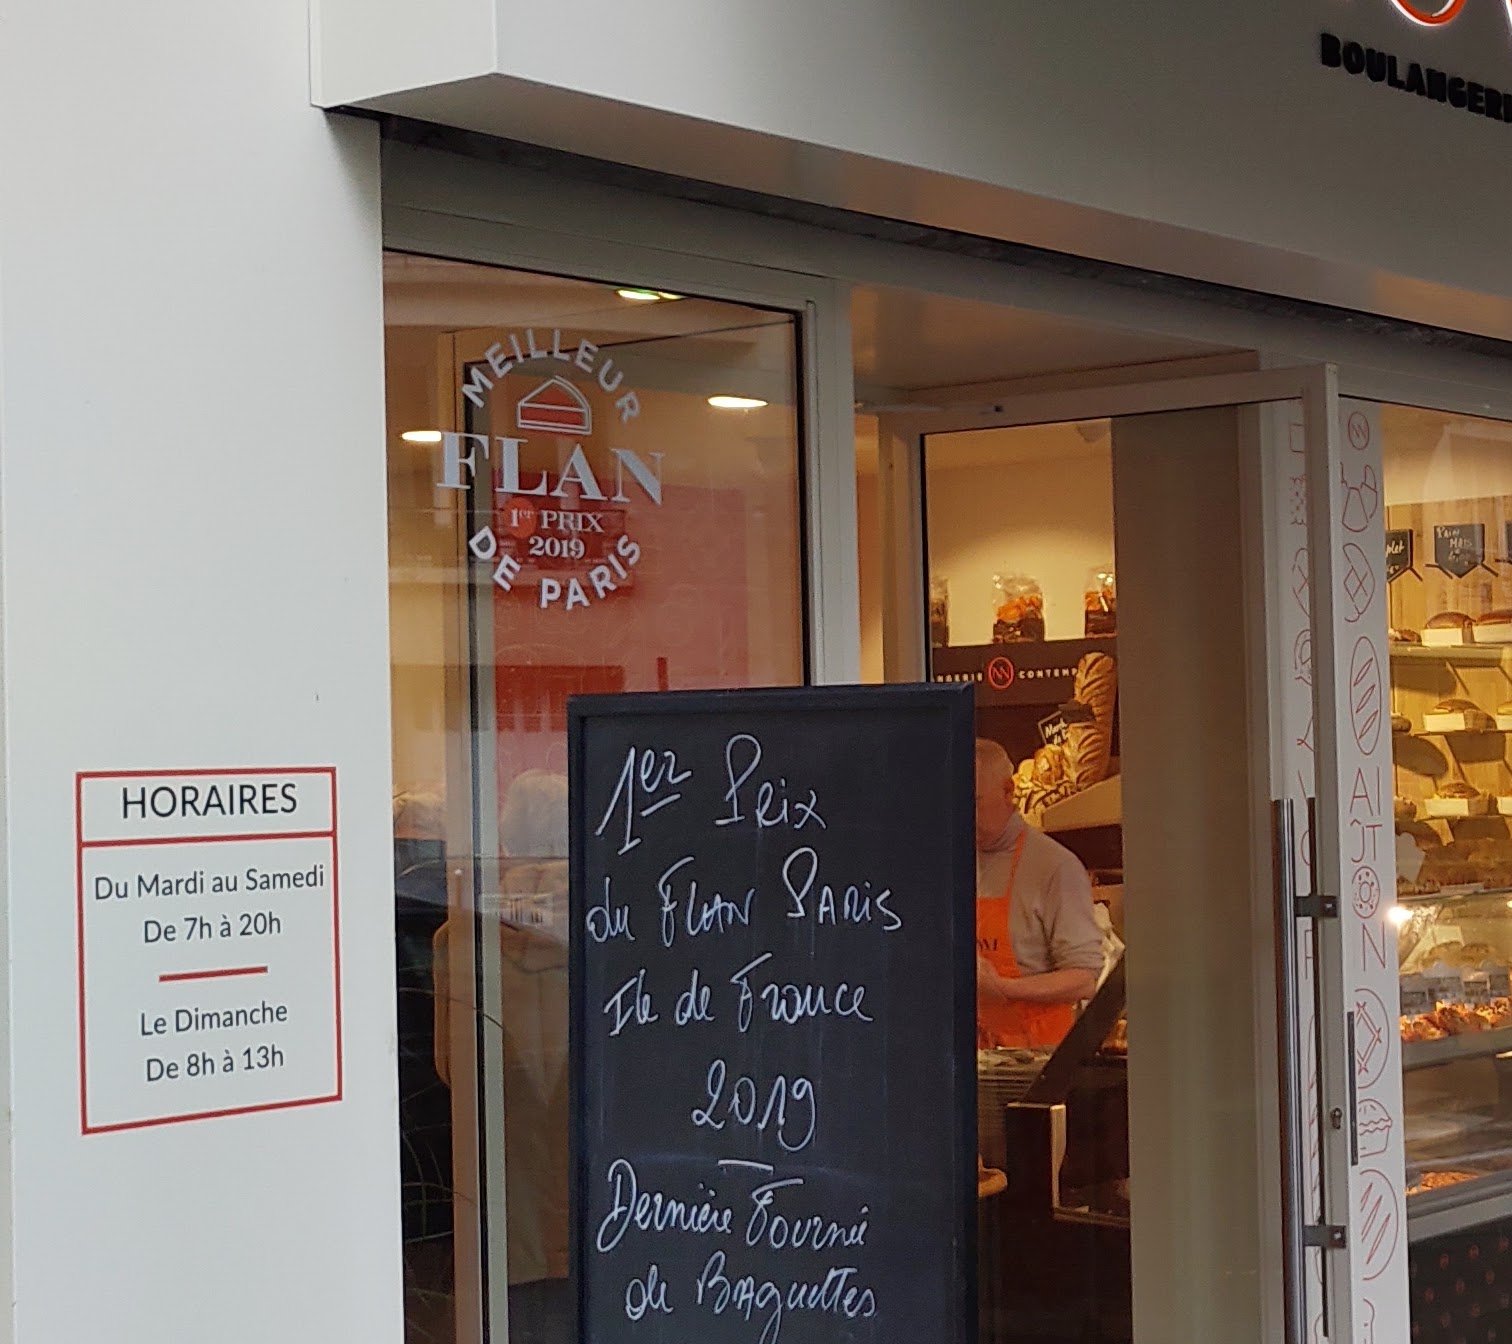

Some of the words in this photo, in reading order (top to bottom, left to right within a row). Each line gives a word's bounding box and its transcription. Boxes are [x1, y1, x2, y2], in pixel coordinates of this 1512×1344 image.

[461, 328, 641, 423] MEILLEUR
[436, 432, 666, 505] FLAN
[540, 510, 604, 533] PRIX
[468, 525, 521, 592] DE
[540, 534, 641, 611] PARIS
[529, 536, 585, 560] 2019
[121, 783, 298, 819] HORAIRES
[95, 876, 129, 901] Du
[137, 871, 205, 898] Mardi
[211, 874, 239, 894] au
[245, 864, 325, 892] Samedi
[144, 919, 177, 944] De
[183, 916, 213, 941] 7h
[219, 914, 232, 938] à
[239, 911, 281, 937] 20h
[586, 876, 636, 944] du
[674, 969, 715, 1026] de
[730, 953, 874, 1034] France
[141, 1013, 167, 1036] Le
[175, 1000, 289, 1033] Dimanche
[146, 1058, 179, 1083] De
[186, 1052, 215, 1078] 8h
[222, 1050, 235, 1074] à
[242, 1043, 284, 1070] 13h
[692, 1058, 818, 1152] 2019
